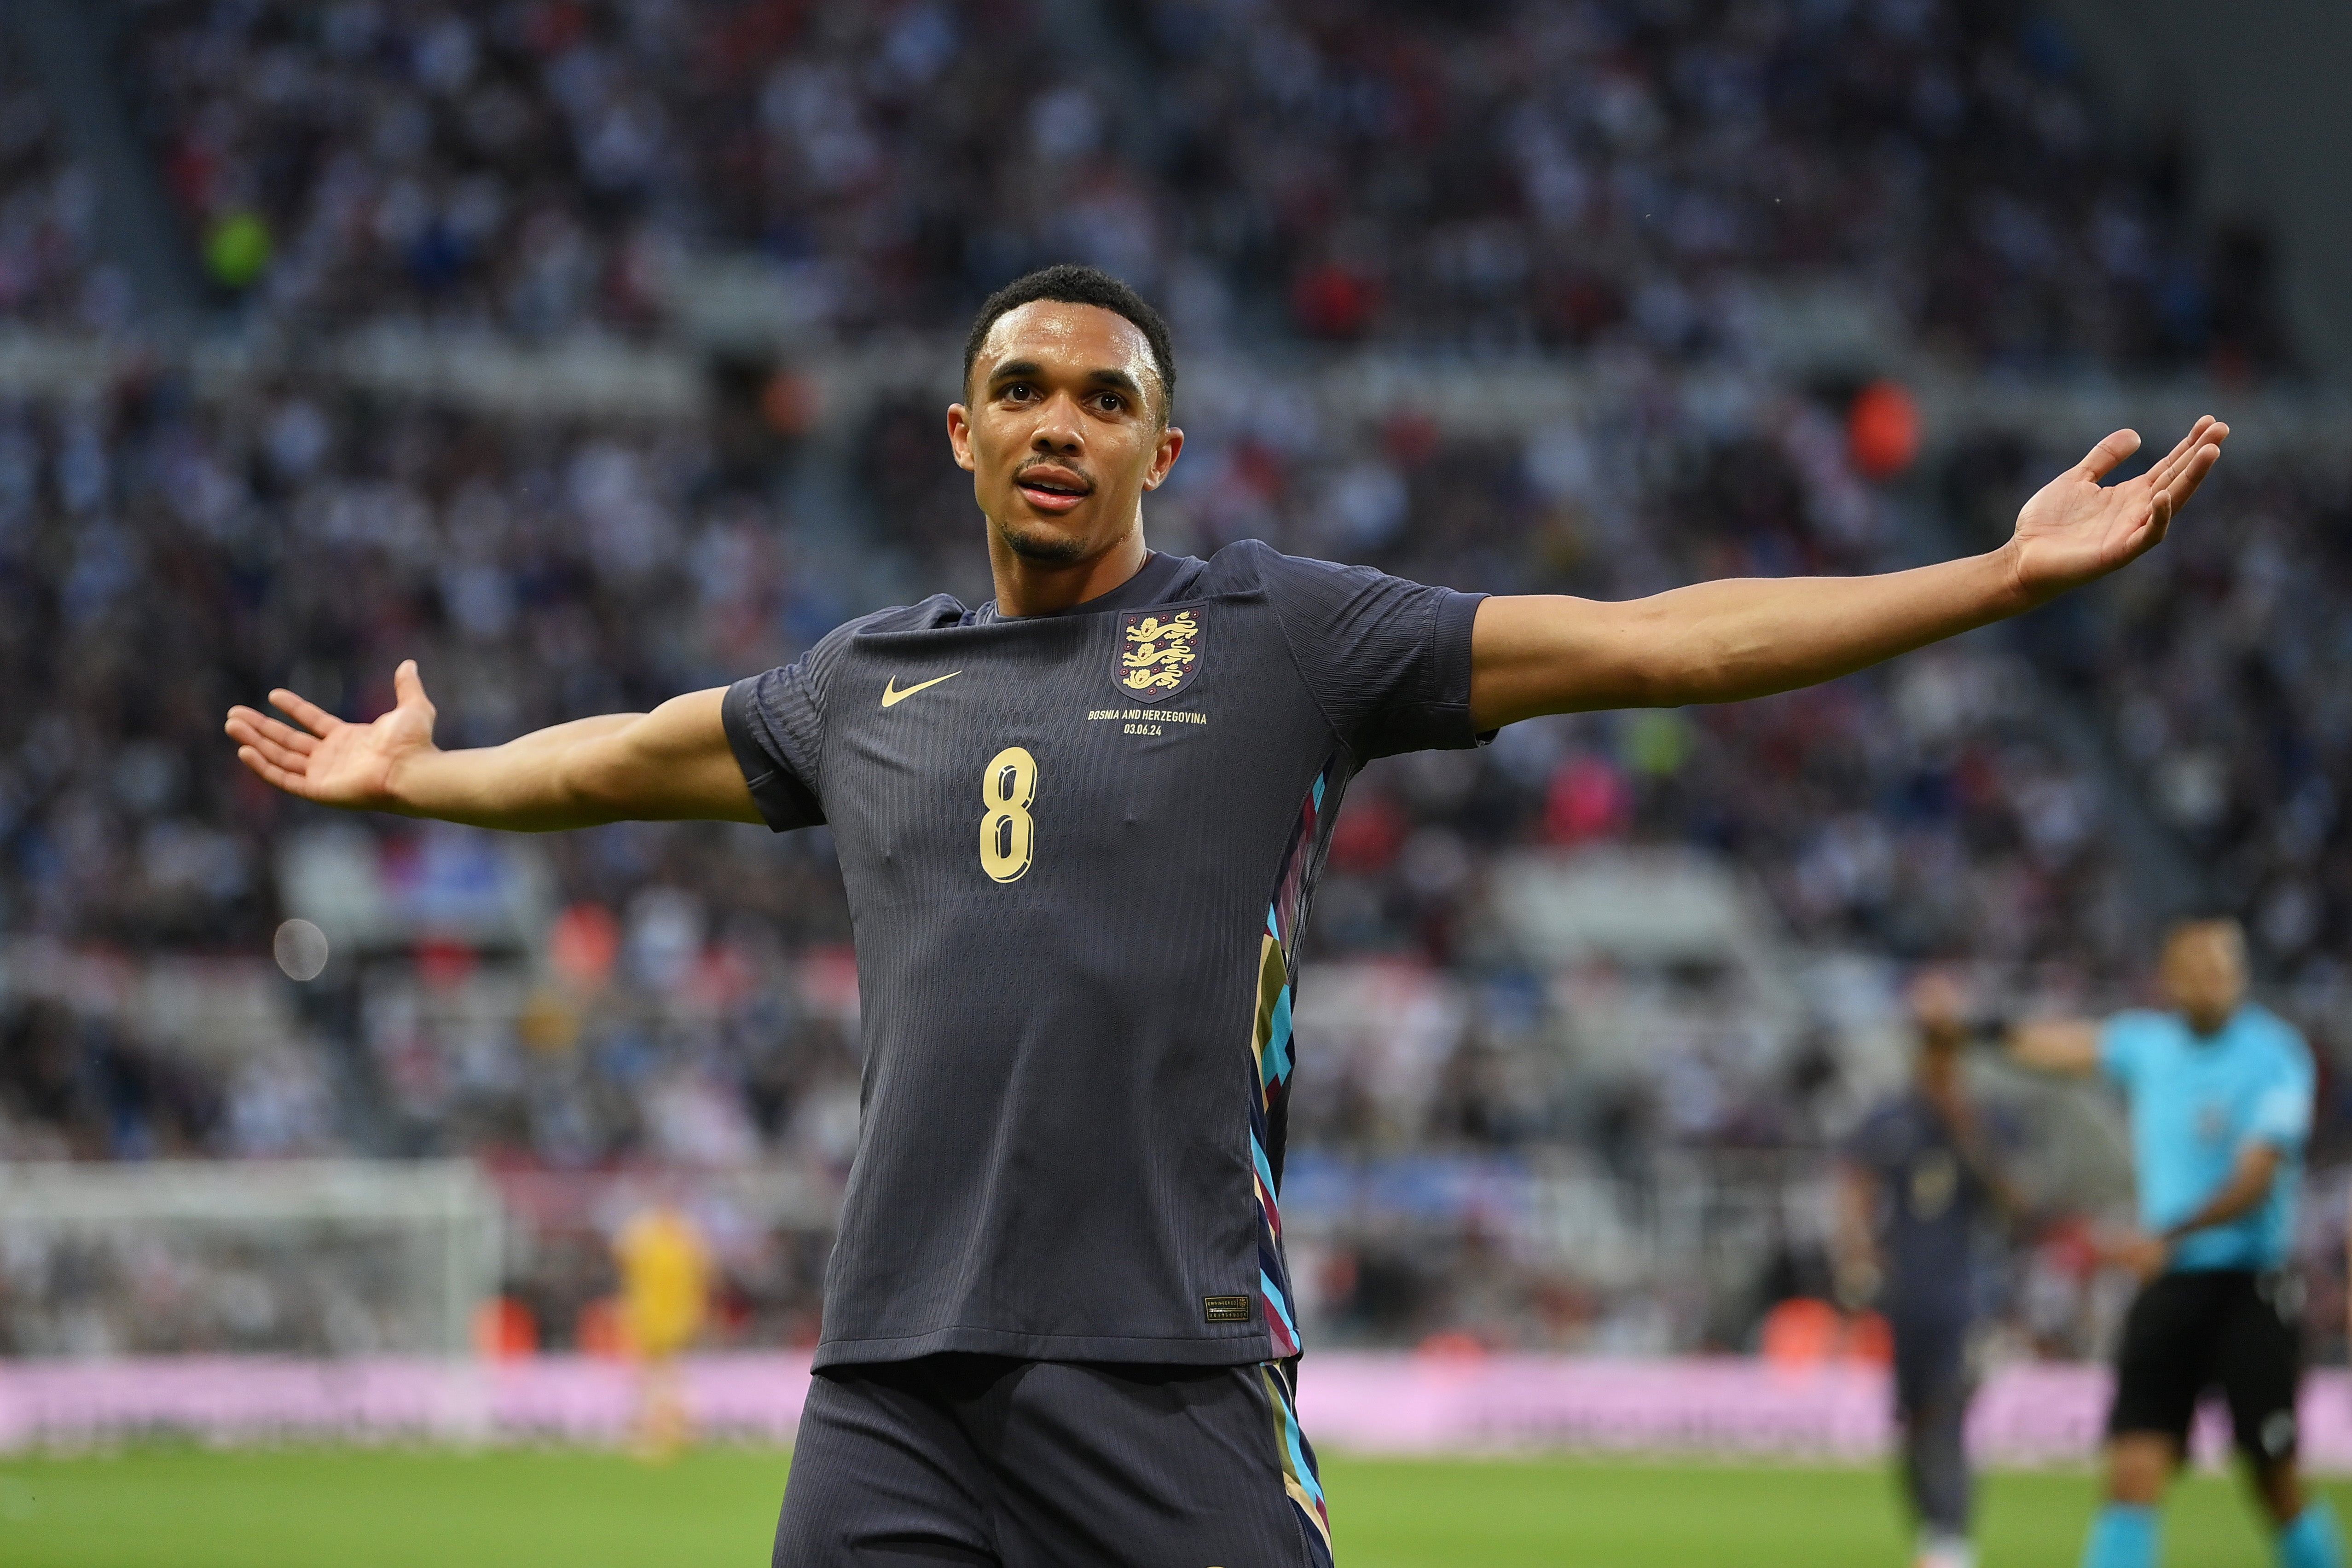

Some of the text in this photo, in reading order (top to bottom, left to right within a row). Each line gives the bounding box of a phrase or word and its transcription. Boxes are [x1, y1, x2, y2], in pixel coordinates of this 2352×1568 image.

[1088, 709, 1207, 724] BOSNIA AND HERZEGOVINA
[1124, 723, 1161, 736] 03.06.24
[979, 746, 1037, 883] 8
